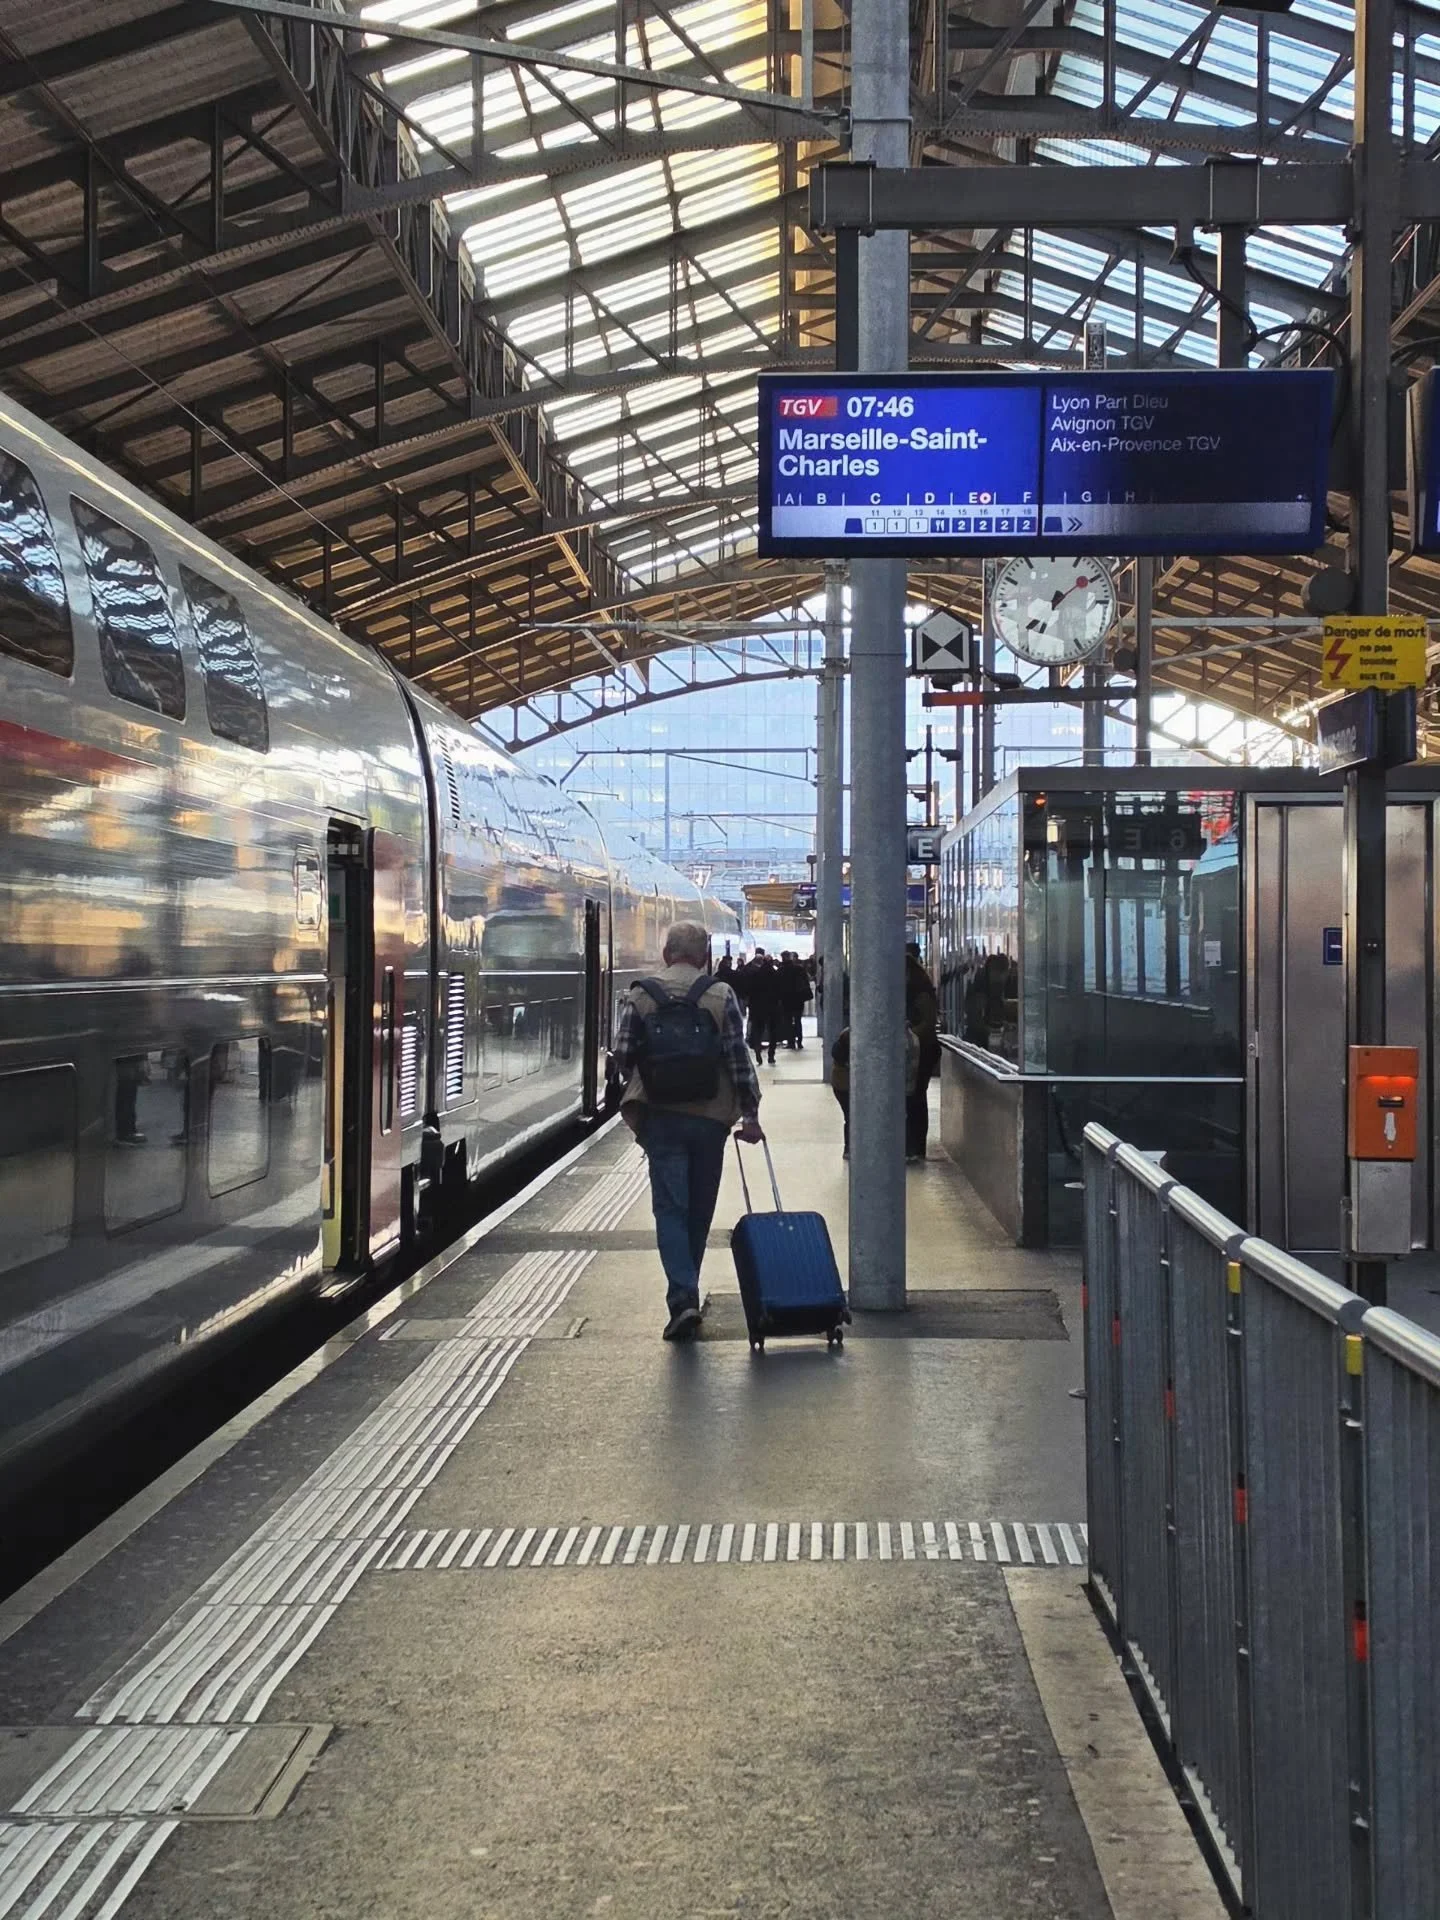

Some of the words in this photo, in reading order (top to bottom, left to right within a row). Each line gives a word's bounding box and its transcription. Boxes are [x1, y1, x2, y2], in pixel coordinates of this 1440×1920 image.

[782, 399, 823, 416] TGV
[847, 396, 914, 418] 07:46
[1052, 395, 1090, 413] Lyon
[1095, 395, 1127, 410] Part
[1133, 394, 1169, 409] Dieu
[1051, 416, 1115, 434] Avignon
[1121, 416, 1155, 430] TGV
[779, 428, 987, 450] Marseille-Saint-
[1050, 437, 1182, 453] Aix-en-Provence
[1187, 436, 1221, 450] TGV
[778, 454, 880, 476] Charles
[785, 493, 795, 504] A
[817, 493, 826, 504] B
[870, 493, 881, 504] C
[925, 493, 935, 504] D
[969, 493, 977, 503] E
[1023, 492, 1031, 503] F
[1081, 492, 1092, 502] G
[873, 521, 877, 531] 1
[895, 521, 899, 531] 1
[916, 521, 920, 530] 1
[958, 520, 966, 530] 2
[980, 520, 988, 530] 2
[1001, 520, 1009, 530] 2
[1022, 520, 1031, 530] 2
[1325, 626, 1371, 639] Danger
[1375, 625, 1391, 636] de
[1395, 627, 1425, 637] mort
[918, 839, 933, 857] E
